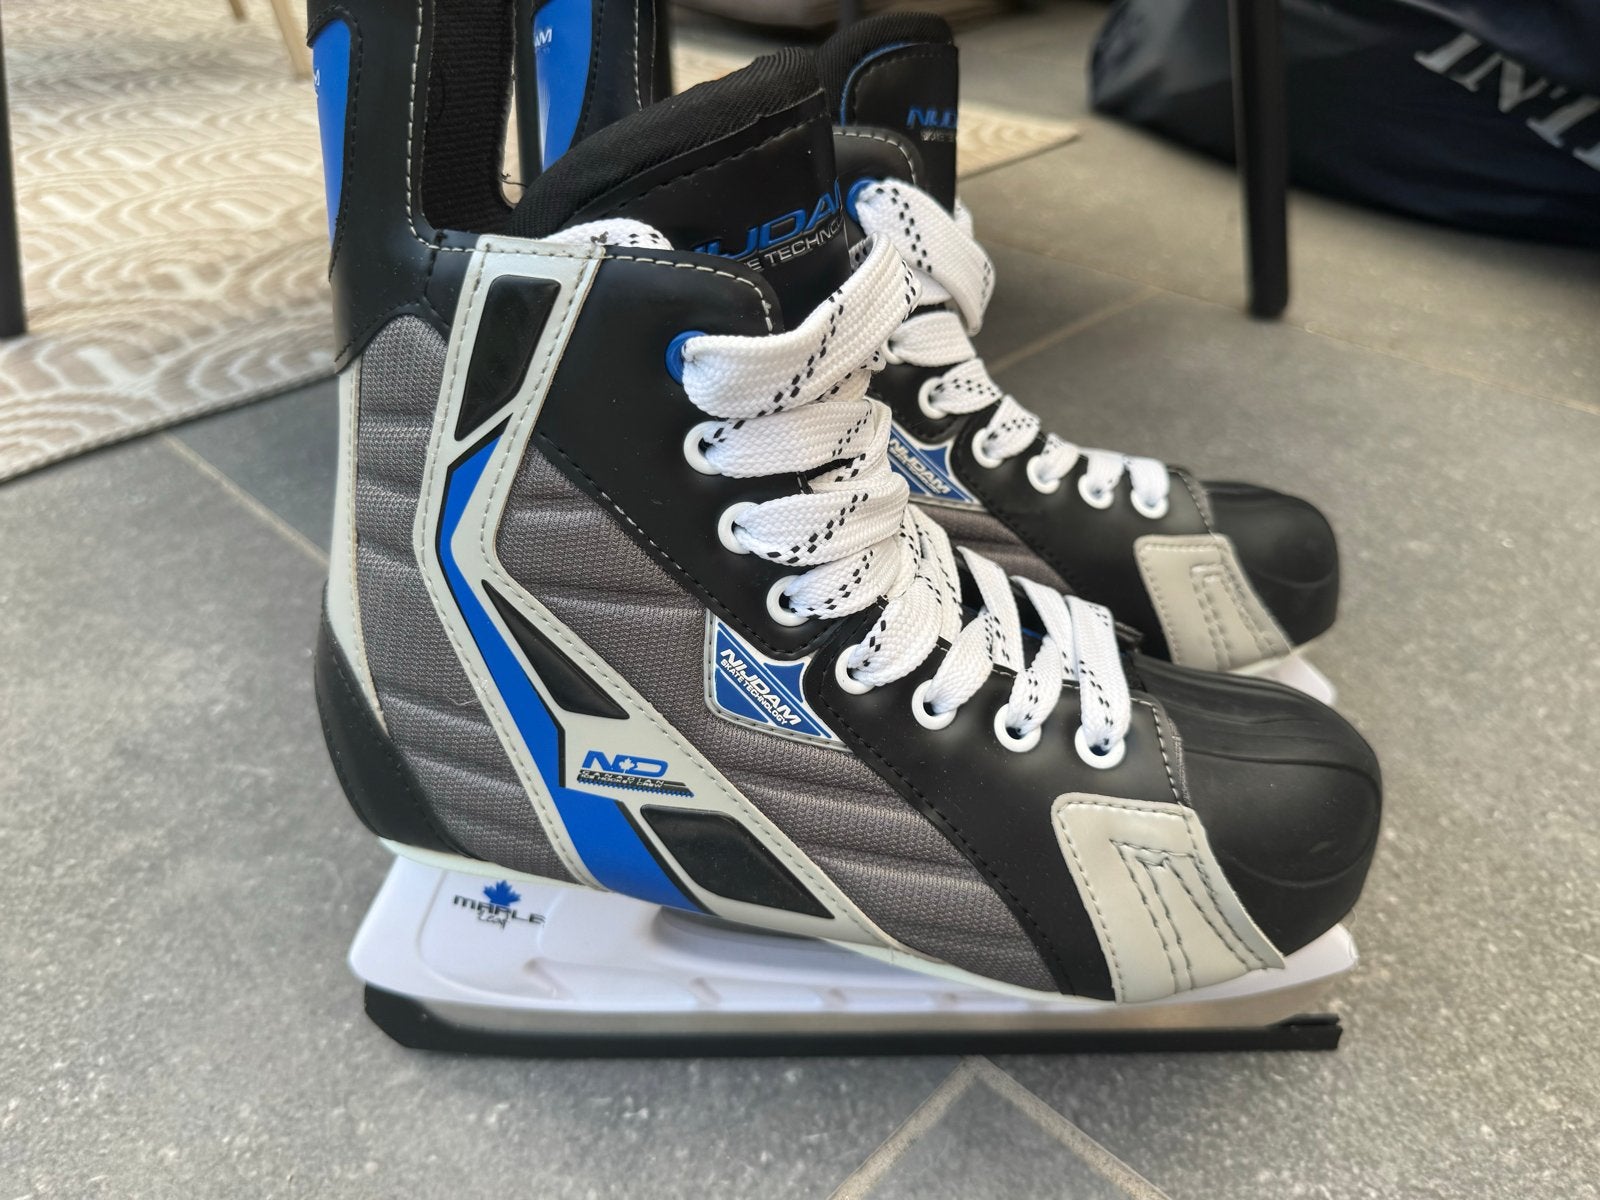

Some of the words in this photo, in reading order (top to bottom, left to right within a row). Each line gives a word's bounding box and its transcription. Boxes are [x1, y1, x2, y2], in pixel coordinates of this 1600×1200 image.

[720, 649, 801, 725] NIJDAM
[720, 659, 743, 683] SKATE
[743, 679, 788, 725] TECHNOLOGY
